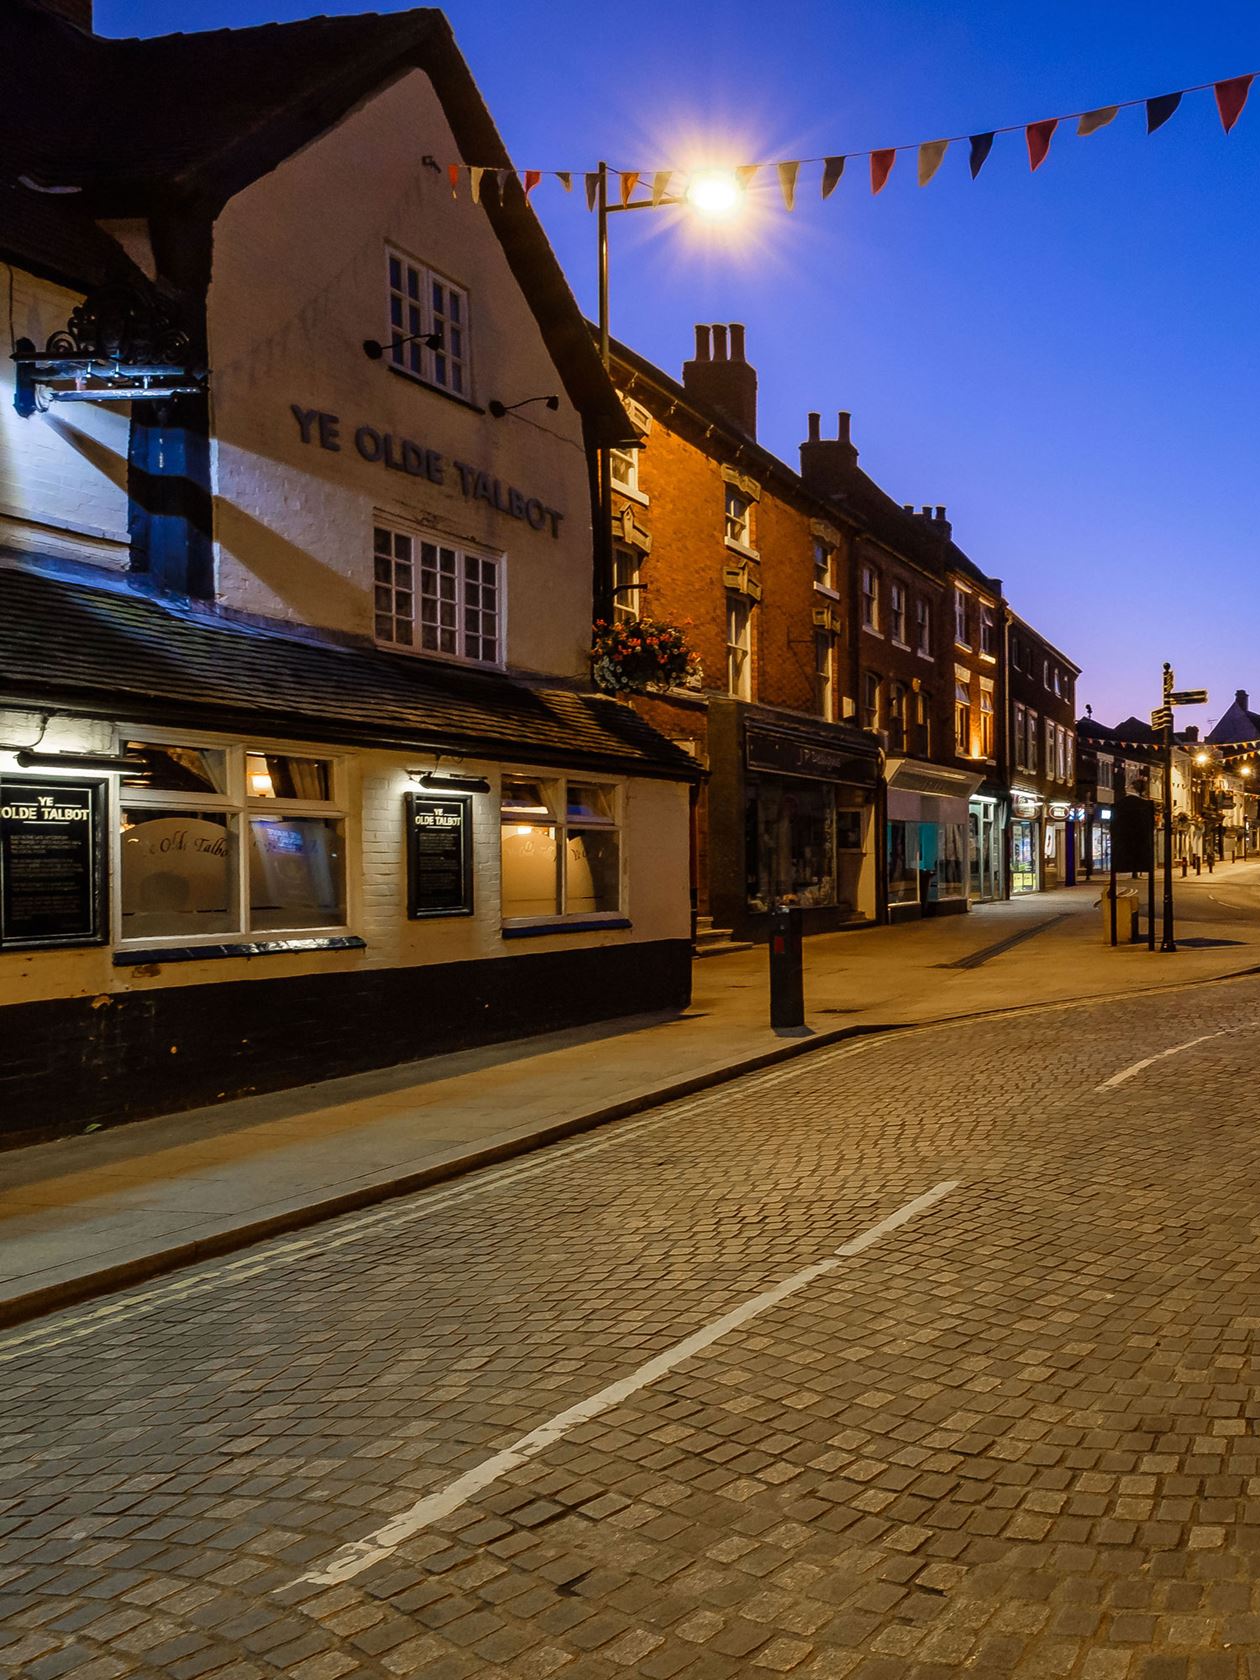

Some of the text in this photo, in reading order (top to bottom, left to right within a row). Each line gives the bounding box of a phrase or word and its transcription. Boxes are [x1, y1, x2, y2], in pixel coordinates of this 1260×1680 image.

[291, 404, 565, 540] YE OLDE TALBOT
[37, 796, 54, 807] YE
[1, 806, 89, 820] OLDE TALBOT
[433, 808, 443, 816] YE
[415, 816, 461, 826] OLDE TALBOT
